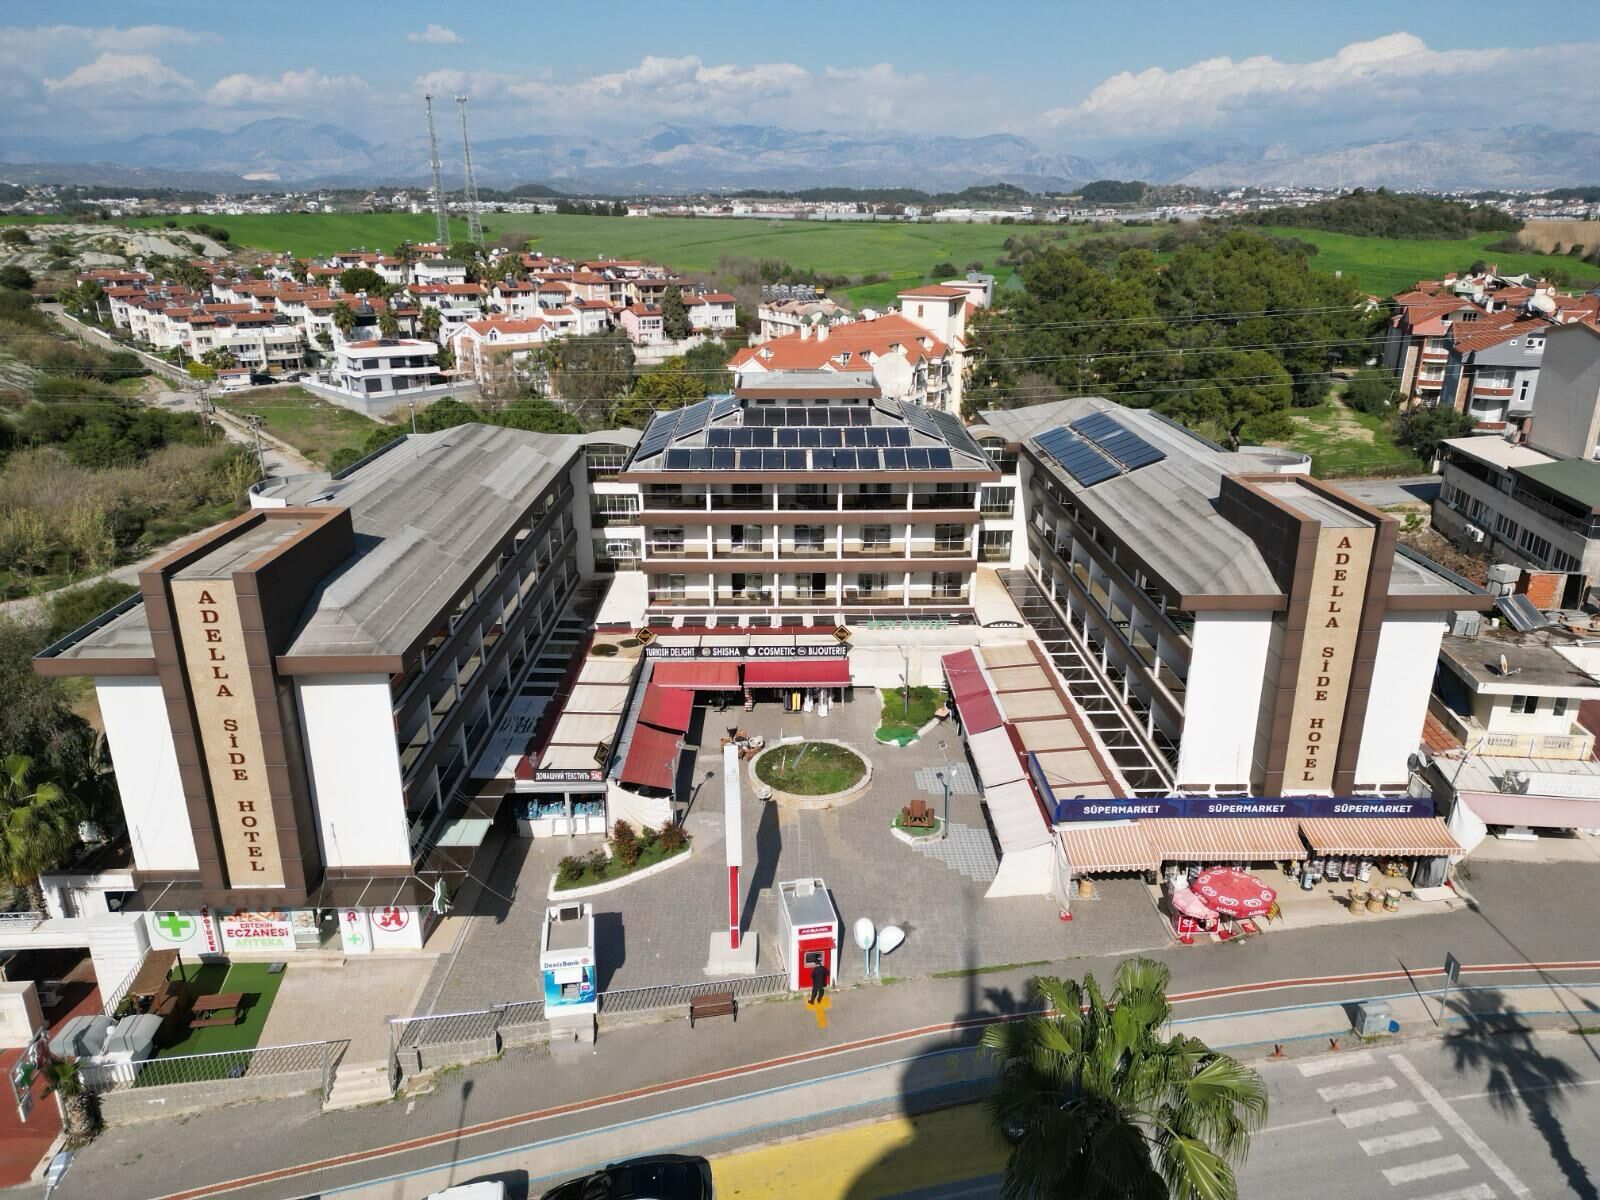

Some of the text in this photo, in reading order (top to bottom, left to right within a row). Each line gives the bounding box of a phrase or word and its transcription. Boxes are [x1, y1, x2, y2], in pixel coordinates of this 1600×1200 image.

[1325, 536, 1352, 628] ADELLA
[645, 646, 846, 656] TURKISH DELIGHT SHISHA COSMETIC BIJOUTERIE
[198, 590, 234, 697] ADELLA
[238, 801, 265, 872] HOTEL
[1302, 718, 1324, 781] HOTEL
[536, 771, 589, 780] ДОМАШНИЙ ТЕКСТИЛЬ
[1083, 804, 1161, 814] SÜPERMARKET
[1208, 804, 1286, 813] SÜPERMARKET
[1333, 804, 1413, 813] SÜPERMARKET
[801, 927, 829, 935] AKBANK
